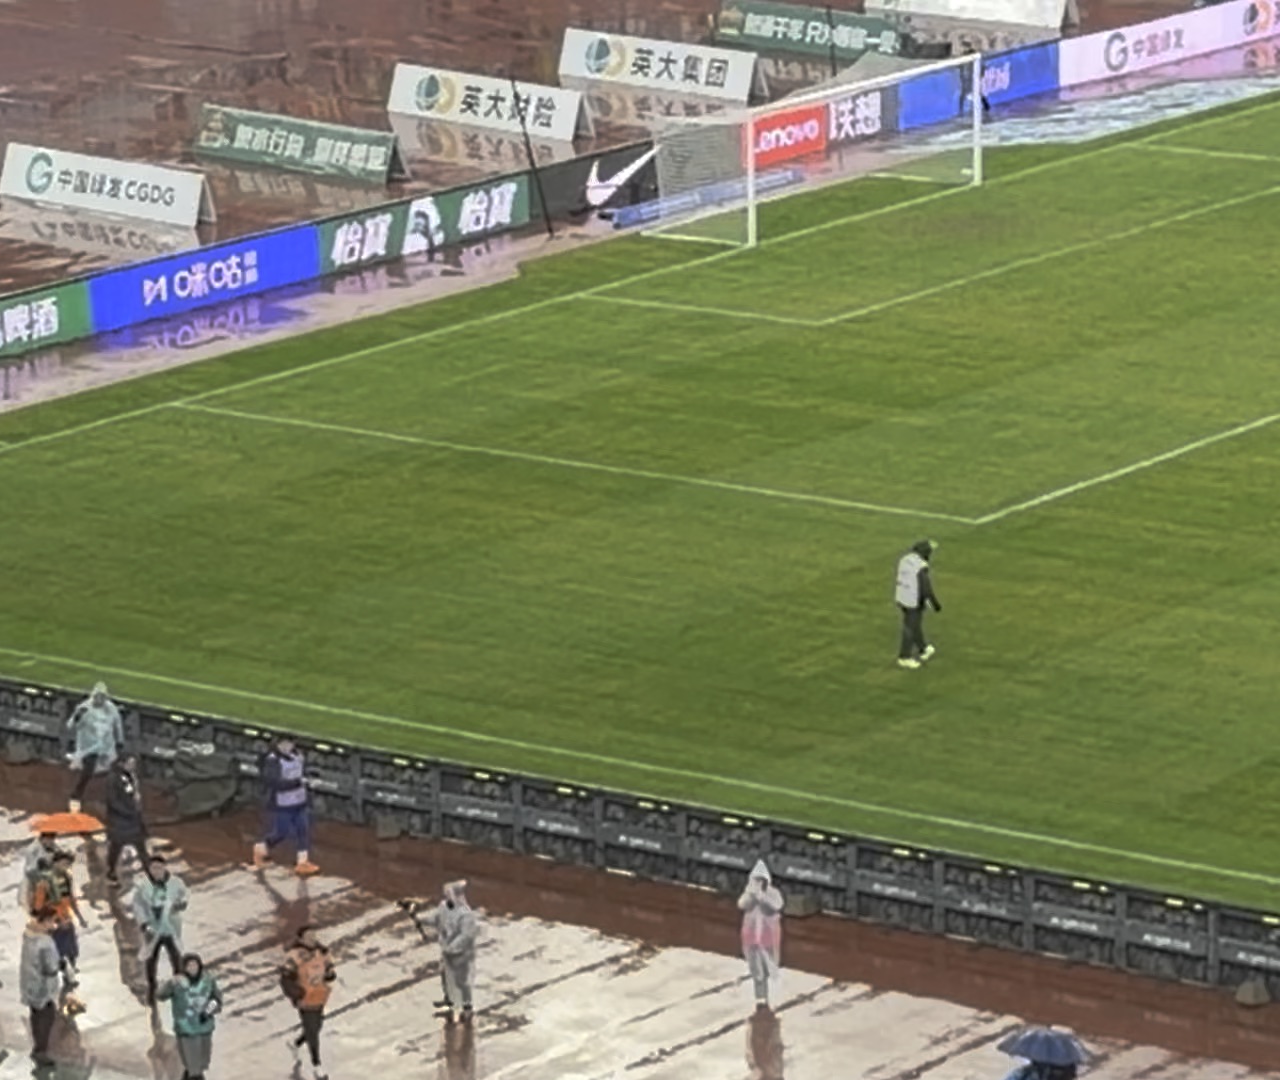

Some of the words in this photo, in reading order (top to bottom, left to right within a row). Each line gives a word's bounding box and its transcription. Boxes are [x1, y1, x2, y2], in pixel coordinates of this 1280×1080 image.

[630, 47, 729, 88] 英大集团
[459, 84, 556, 129] 英大财险
[58, 168, 123, 201] 中国绿发
[124, 180, 176, 207] CGDG
